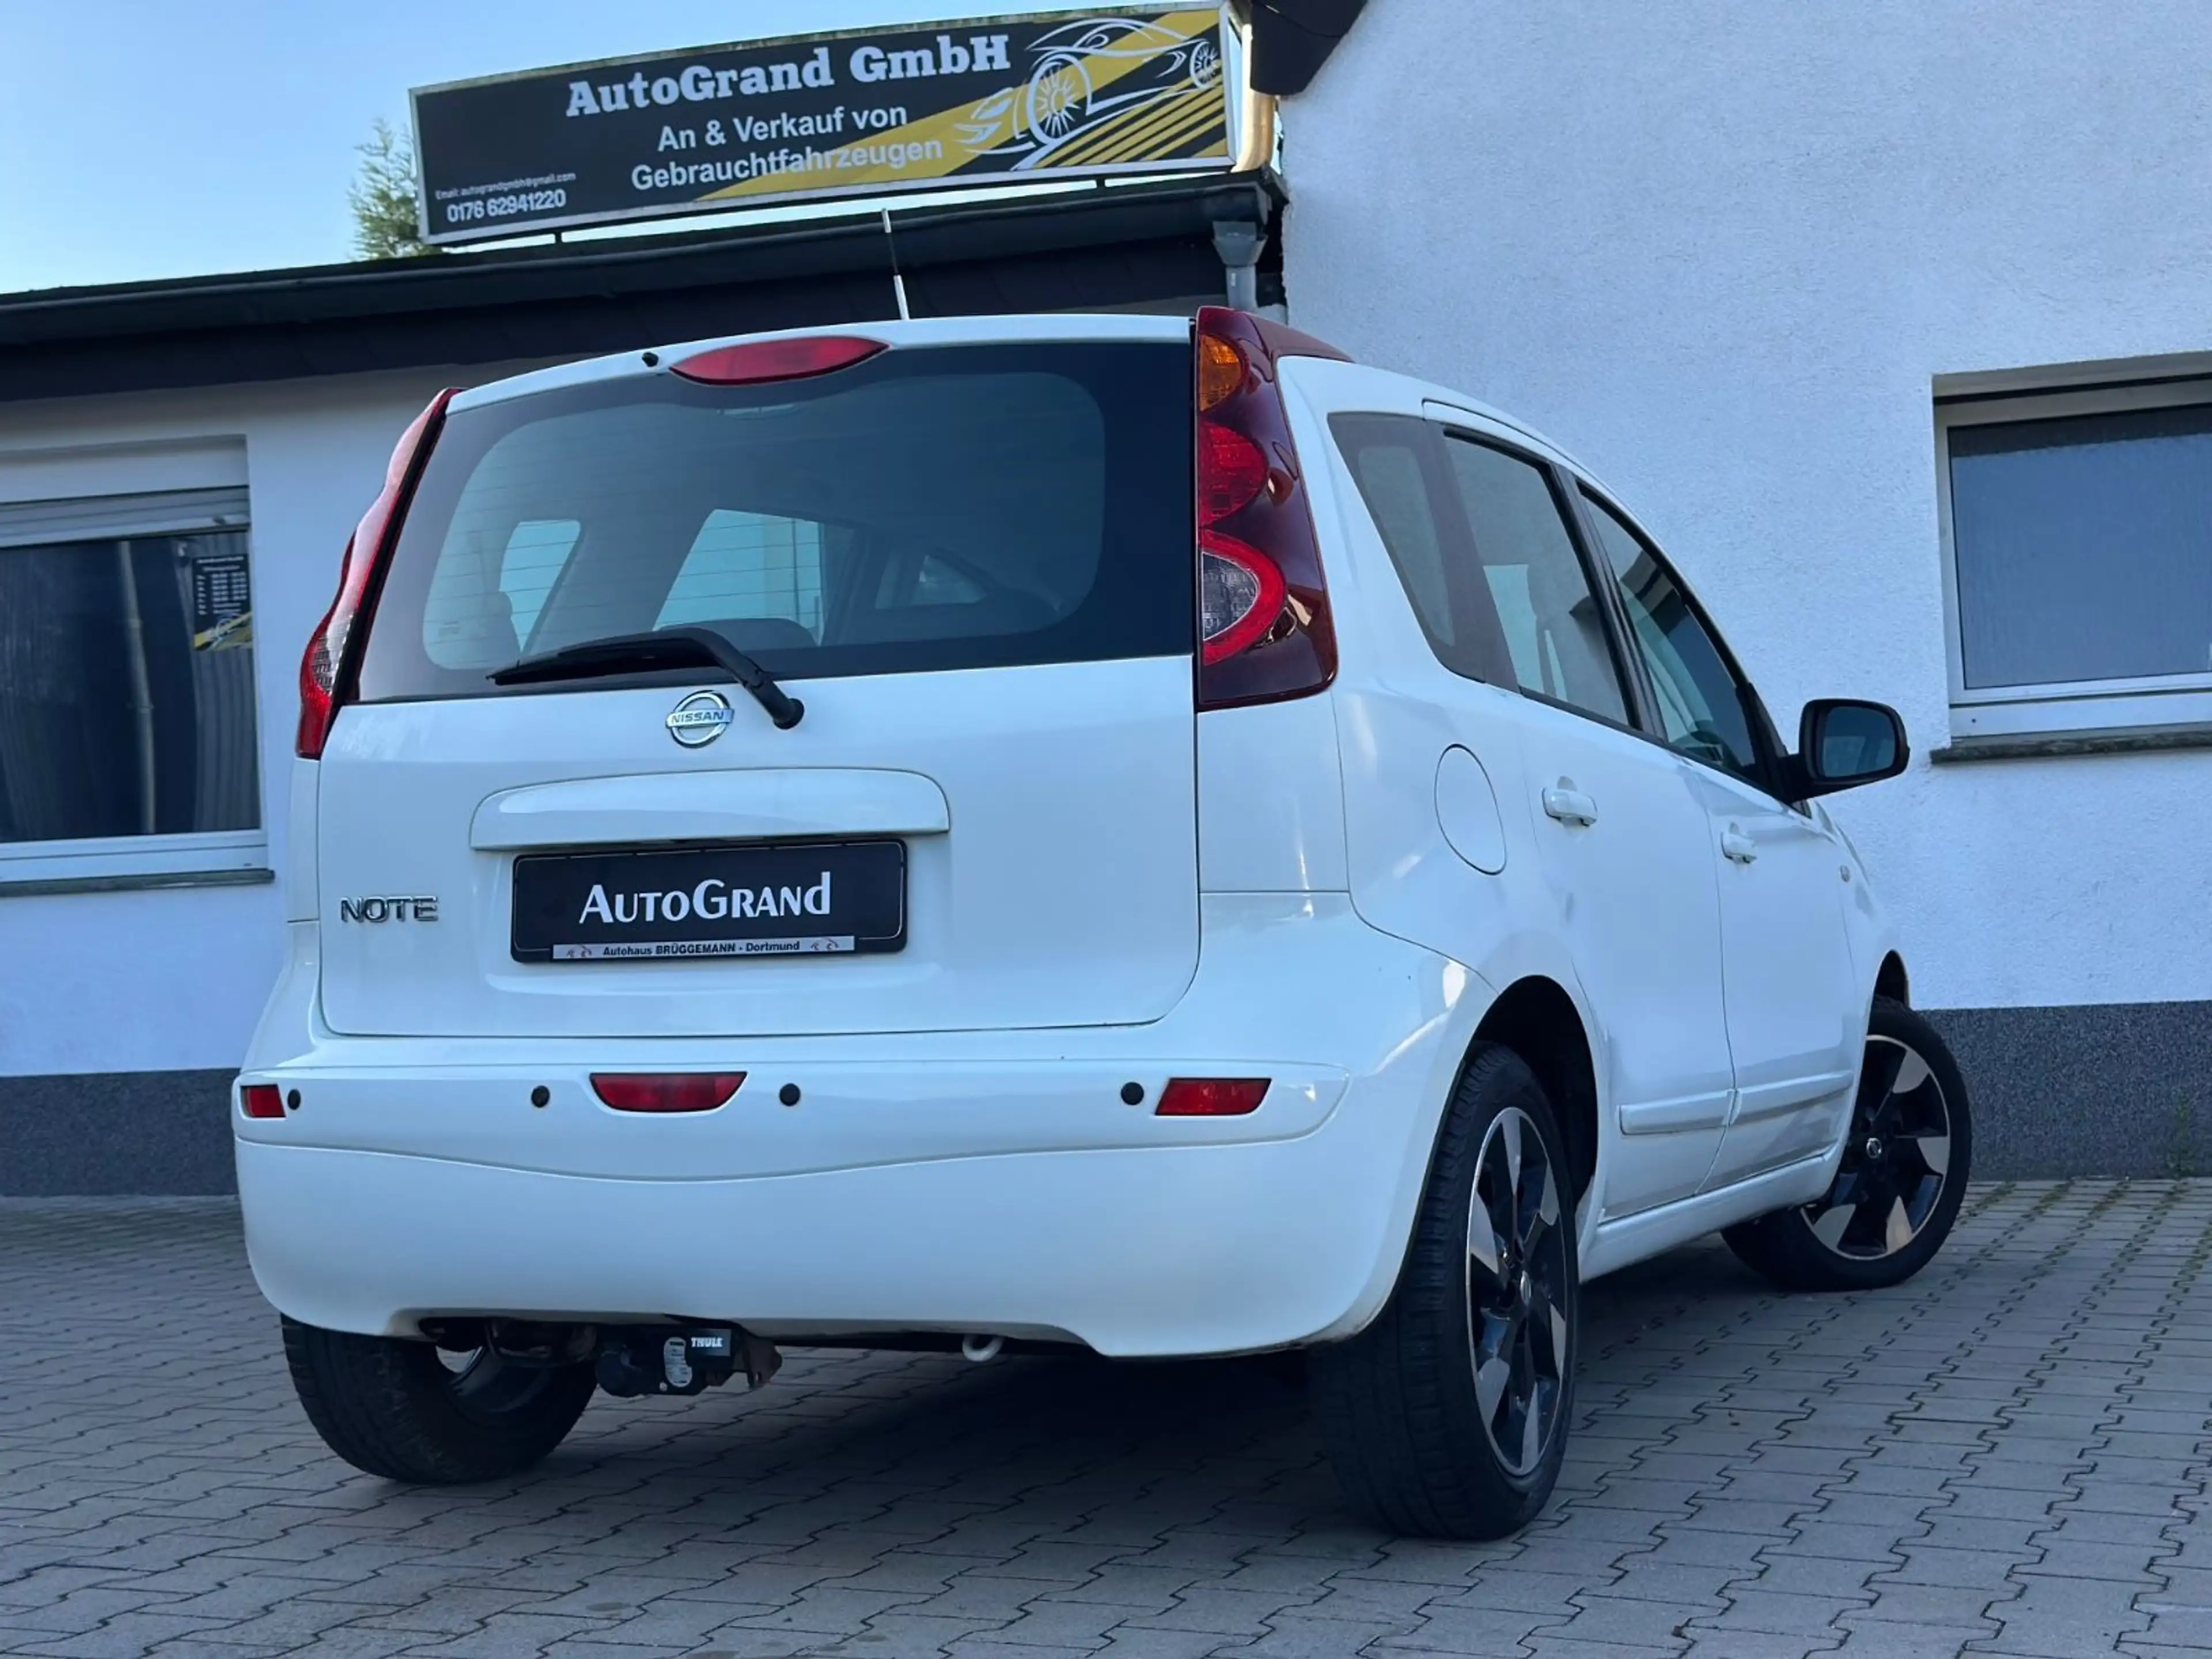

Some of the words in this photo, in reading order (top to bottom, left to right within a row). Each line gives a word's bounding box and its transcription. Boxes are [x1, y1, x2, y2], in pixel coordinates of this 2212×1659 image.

[566, 47, 835, 117] AutoGrand
[849, 34, 1011, 83] GmbH
[657, 125, 696, 152] An
[704, 119, 726, 146] &
[733, 106, 845, 143] Verkauf
[851, 106, 908, 130] von
[632, 138, 944, 190] Gebrauchtfahrzeugen
[446, 200, 485, 223] 0176
[486, 188, 567, 217] 62941220
[671, 711, 724, 724] NISSAN
[340, 896, 438, 923] NOTE
[603, 945, 653, 956] Autohaus
[655, 942, 736, 955] BRÜGGEMANN
[745, 941, 801, 952] Dortmund
[691, 1337, 724, 1348] THULE
